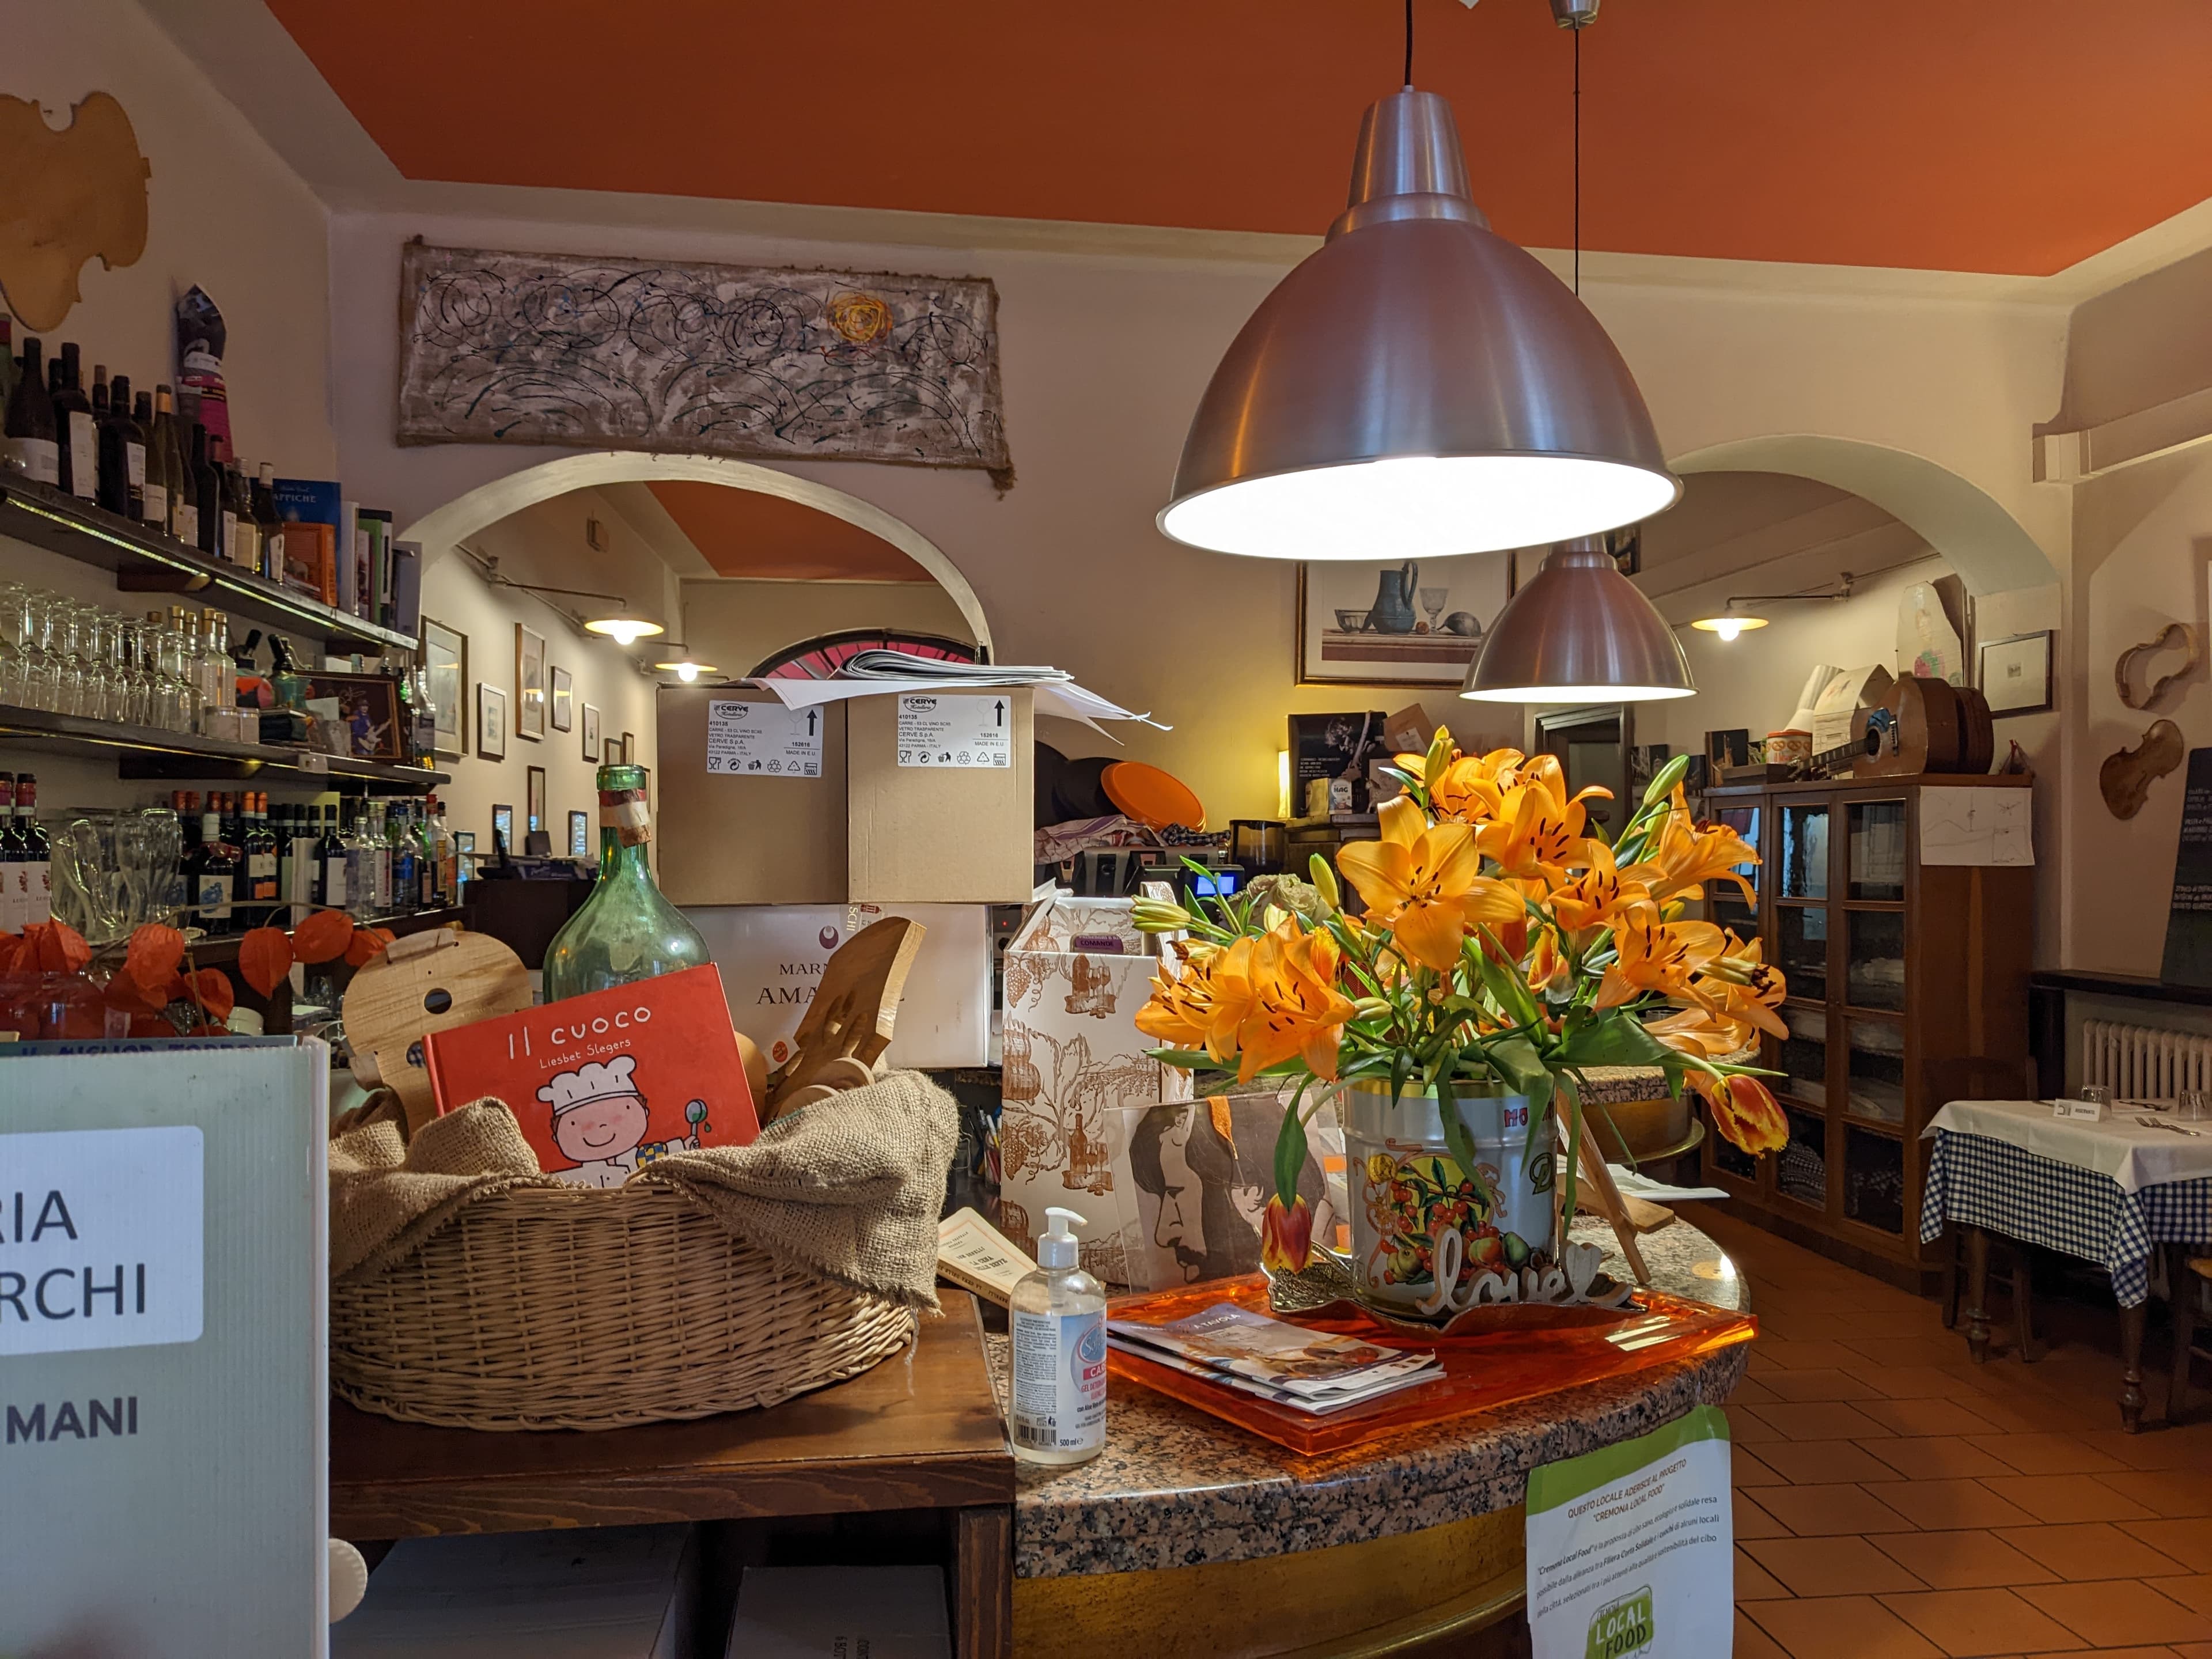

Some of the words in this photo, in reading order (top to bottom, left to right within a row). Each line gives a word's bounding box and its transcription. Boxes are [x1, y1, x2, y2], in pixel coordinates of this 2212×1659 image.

[846, 907, 858, 931] SCHI
[539, 1050, 582, 1069] Liesbet
[586, 1039, 631, 1056] Slegers
[0, 1190, 78, 1243] IA
[6, 1396, 138, 1444] MANI
[1070, 1438, 1077, 1446] ml
[1568, 1499, 1596, 1518] QUESTO
[1596, 1490, 1623, 1507] LOCALE
[1624, 1477, 1652, 1497] ADERISCE
[1652, 1473, 1658, 1482] AL
[1658, 1459, 1687, 1478] PROGETTO
[1630, 1493, 1647, 1510] LOCAL
[1563, 1551, 1578, 1565] Local
[1678, 1497, 1700, 1512] solidale
[1701, 1497, 1718, 1505] resa
[1537, 1581, 1558, 1601] possibile
[1558, 1574, 1572, 1586] dalla
[1681, 1516, 1698, 1529] alcuni
[1699, 1513, 1719, 1524] locali
[1563, 1585, 1591, 1604] selezionati
[1603, 1574, 1611, 1586] più
[1658, 1537, 1688, 1557] sostenibilità
[1689, 1535, 1699, 1545] del
[1700, 1533, 1717, 1543] cibo
[1596, 1602, 1646, 1645] LOCAL
